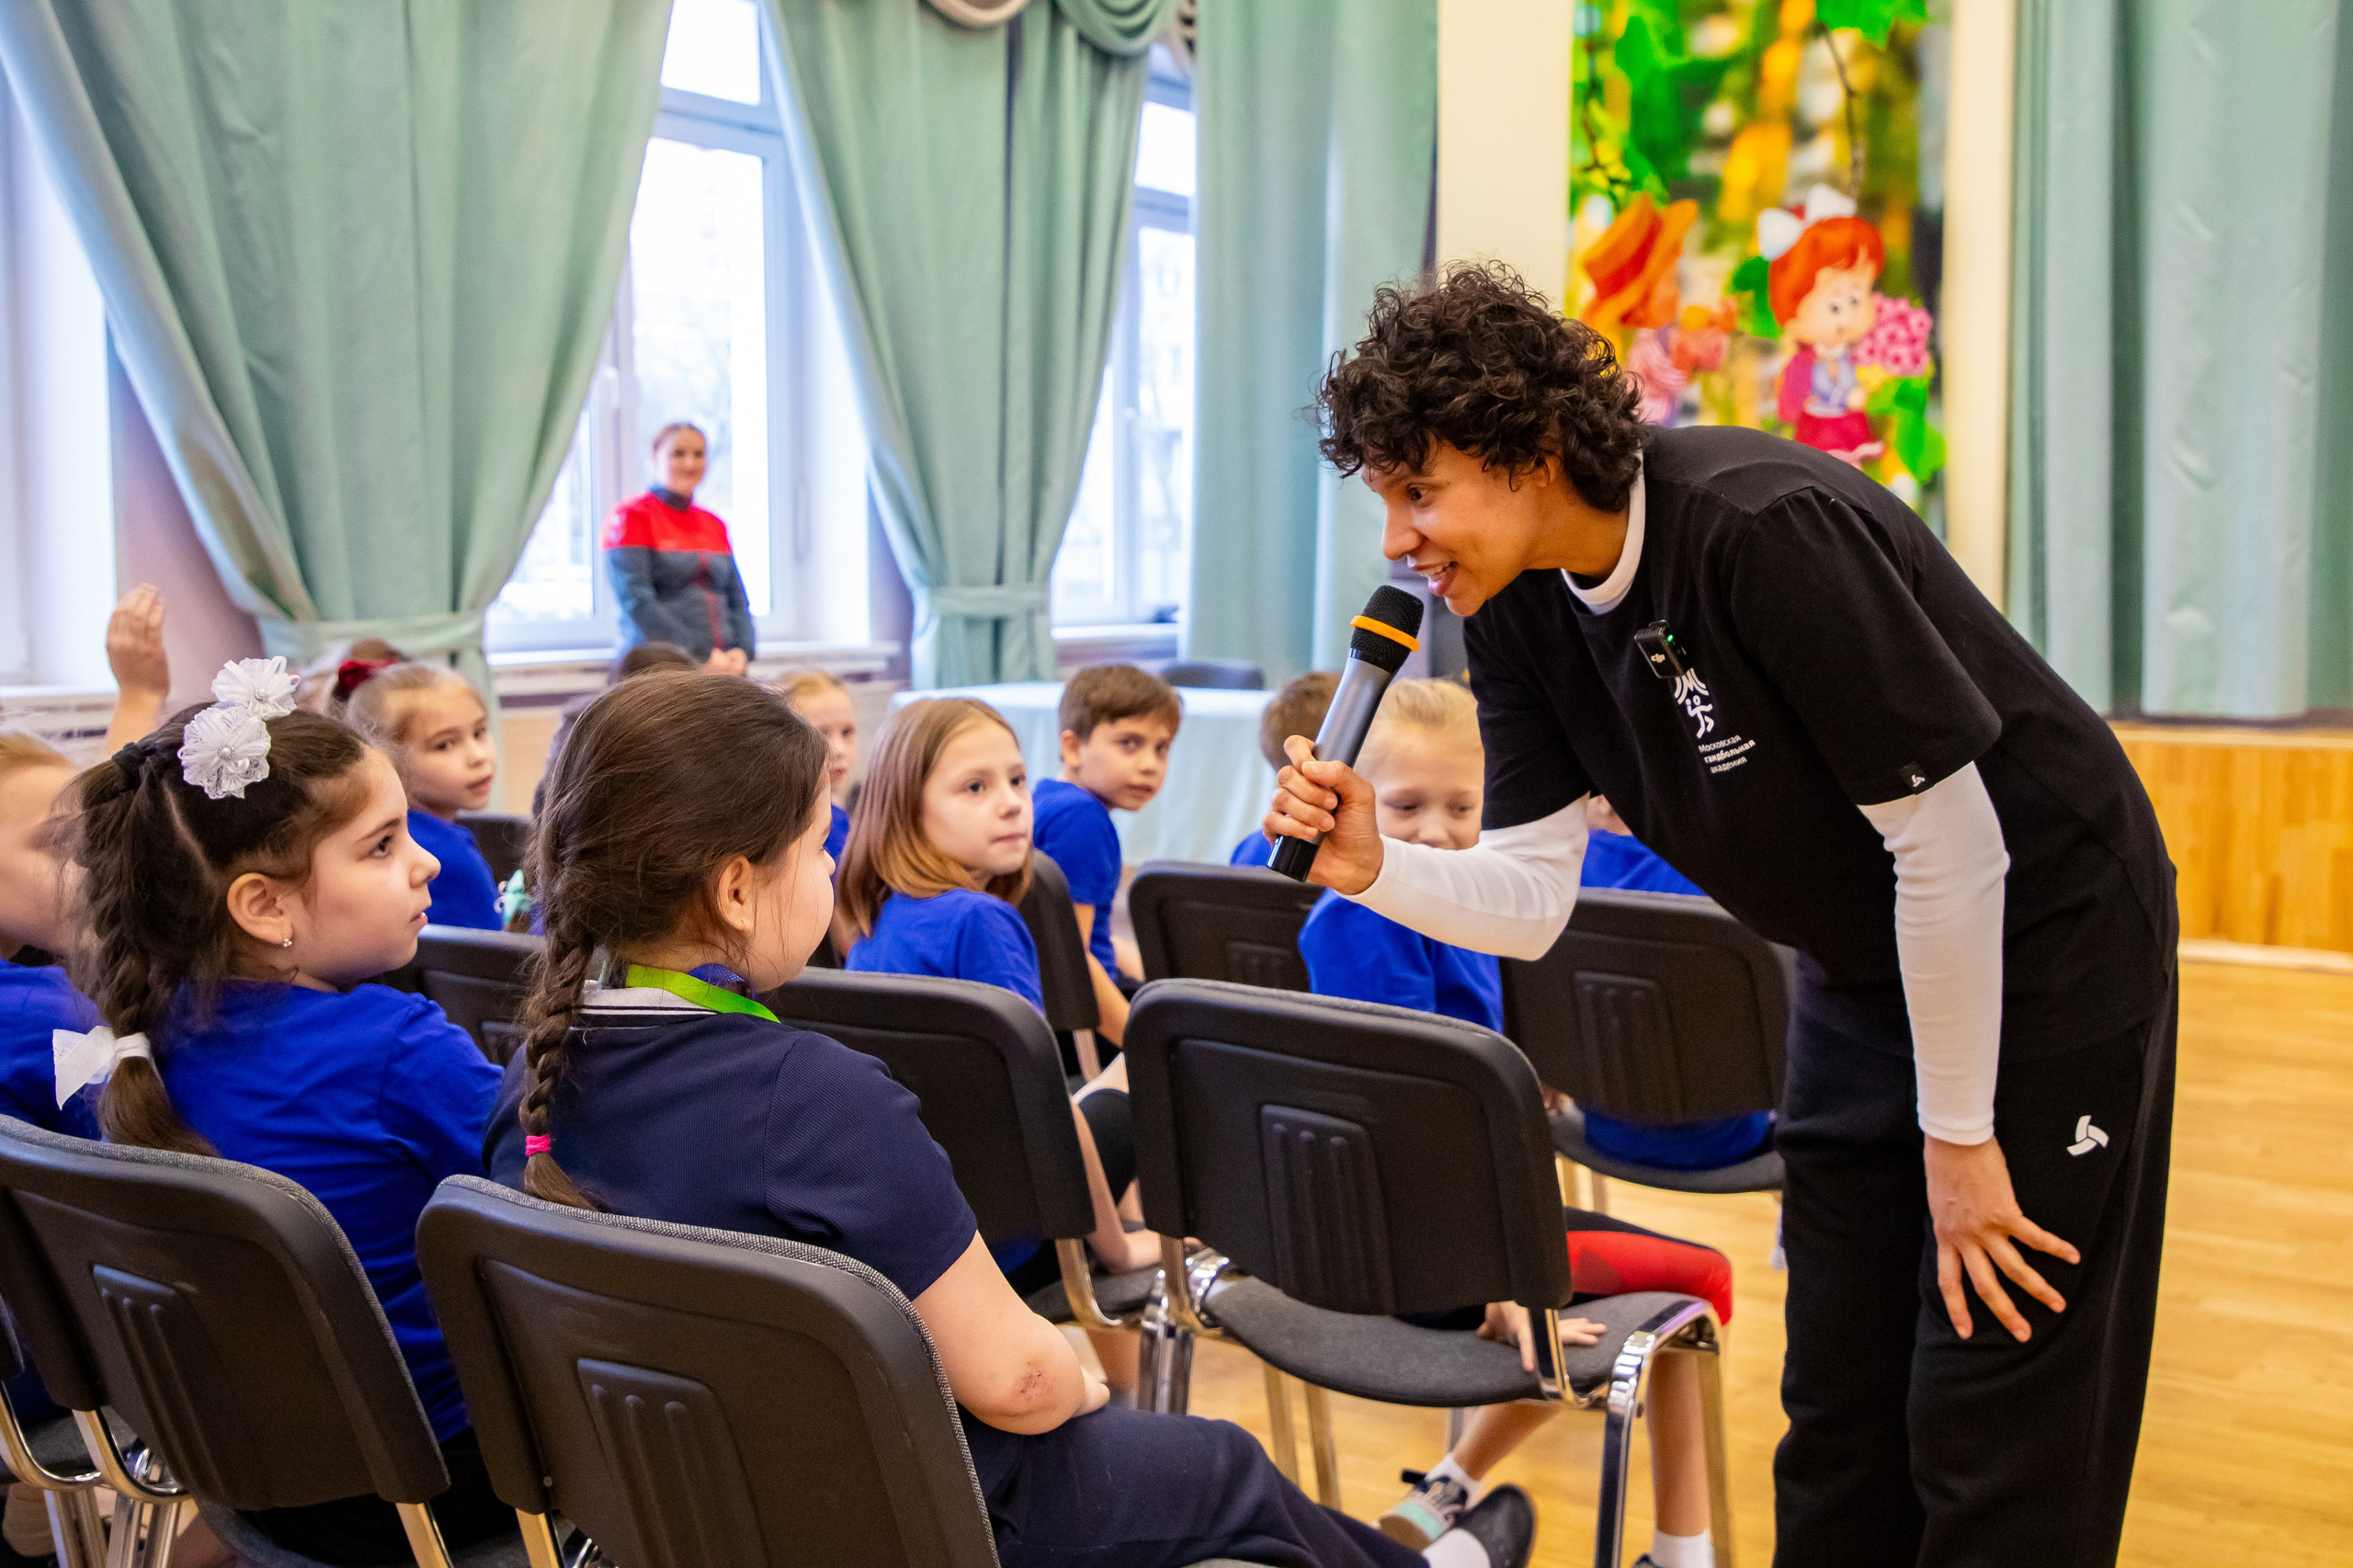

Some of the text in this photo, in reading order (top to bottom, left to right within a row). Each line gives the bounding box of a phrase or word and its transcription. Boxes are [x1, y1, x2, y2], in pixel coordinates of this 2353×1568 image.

[1699, 734, 1742, 753] Московская
[1704, 740, 1756, 764] гандбольная
[1711, 756, 1747, 774] академия
